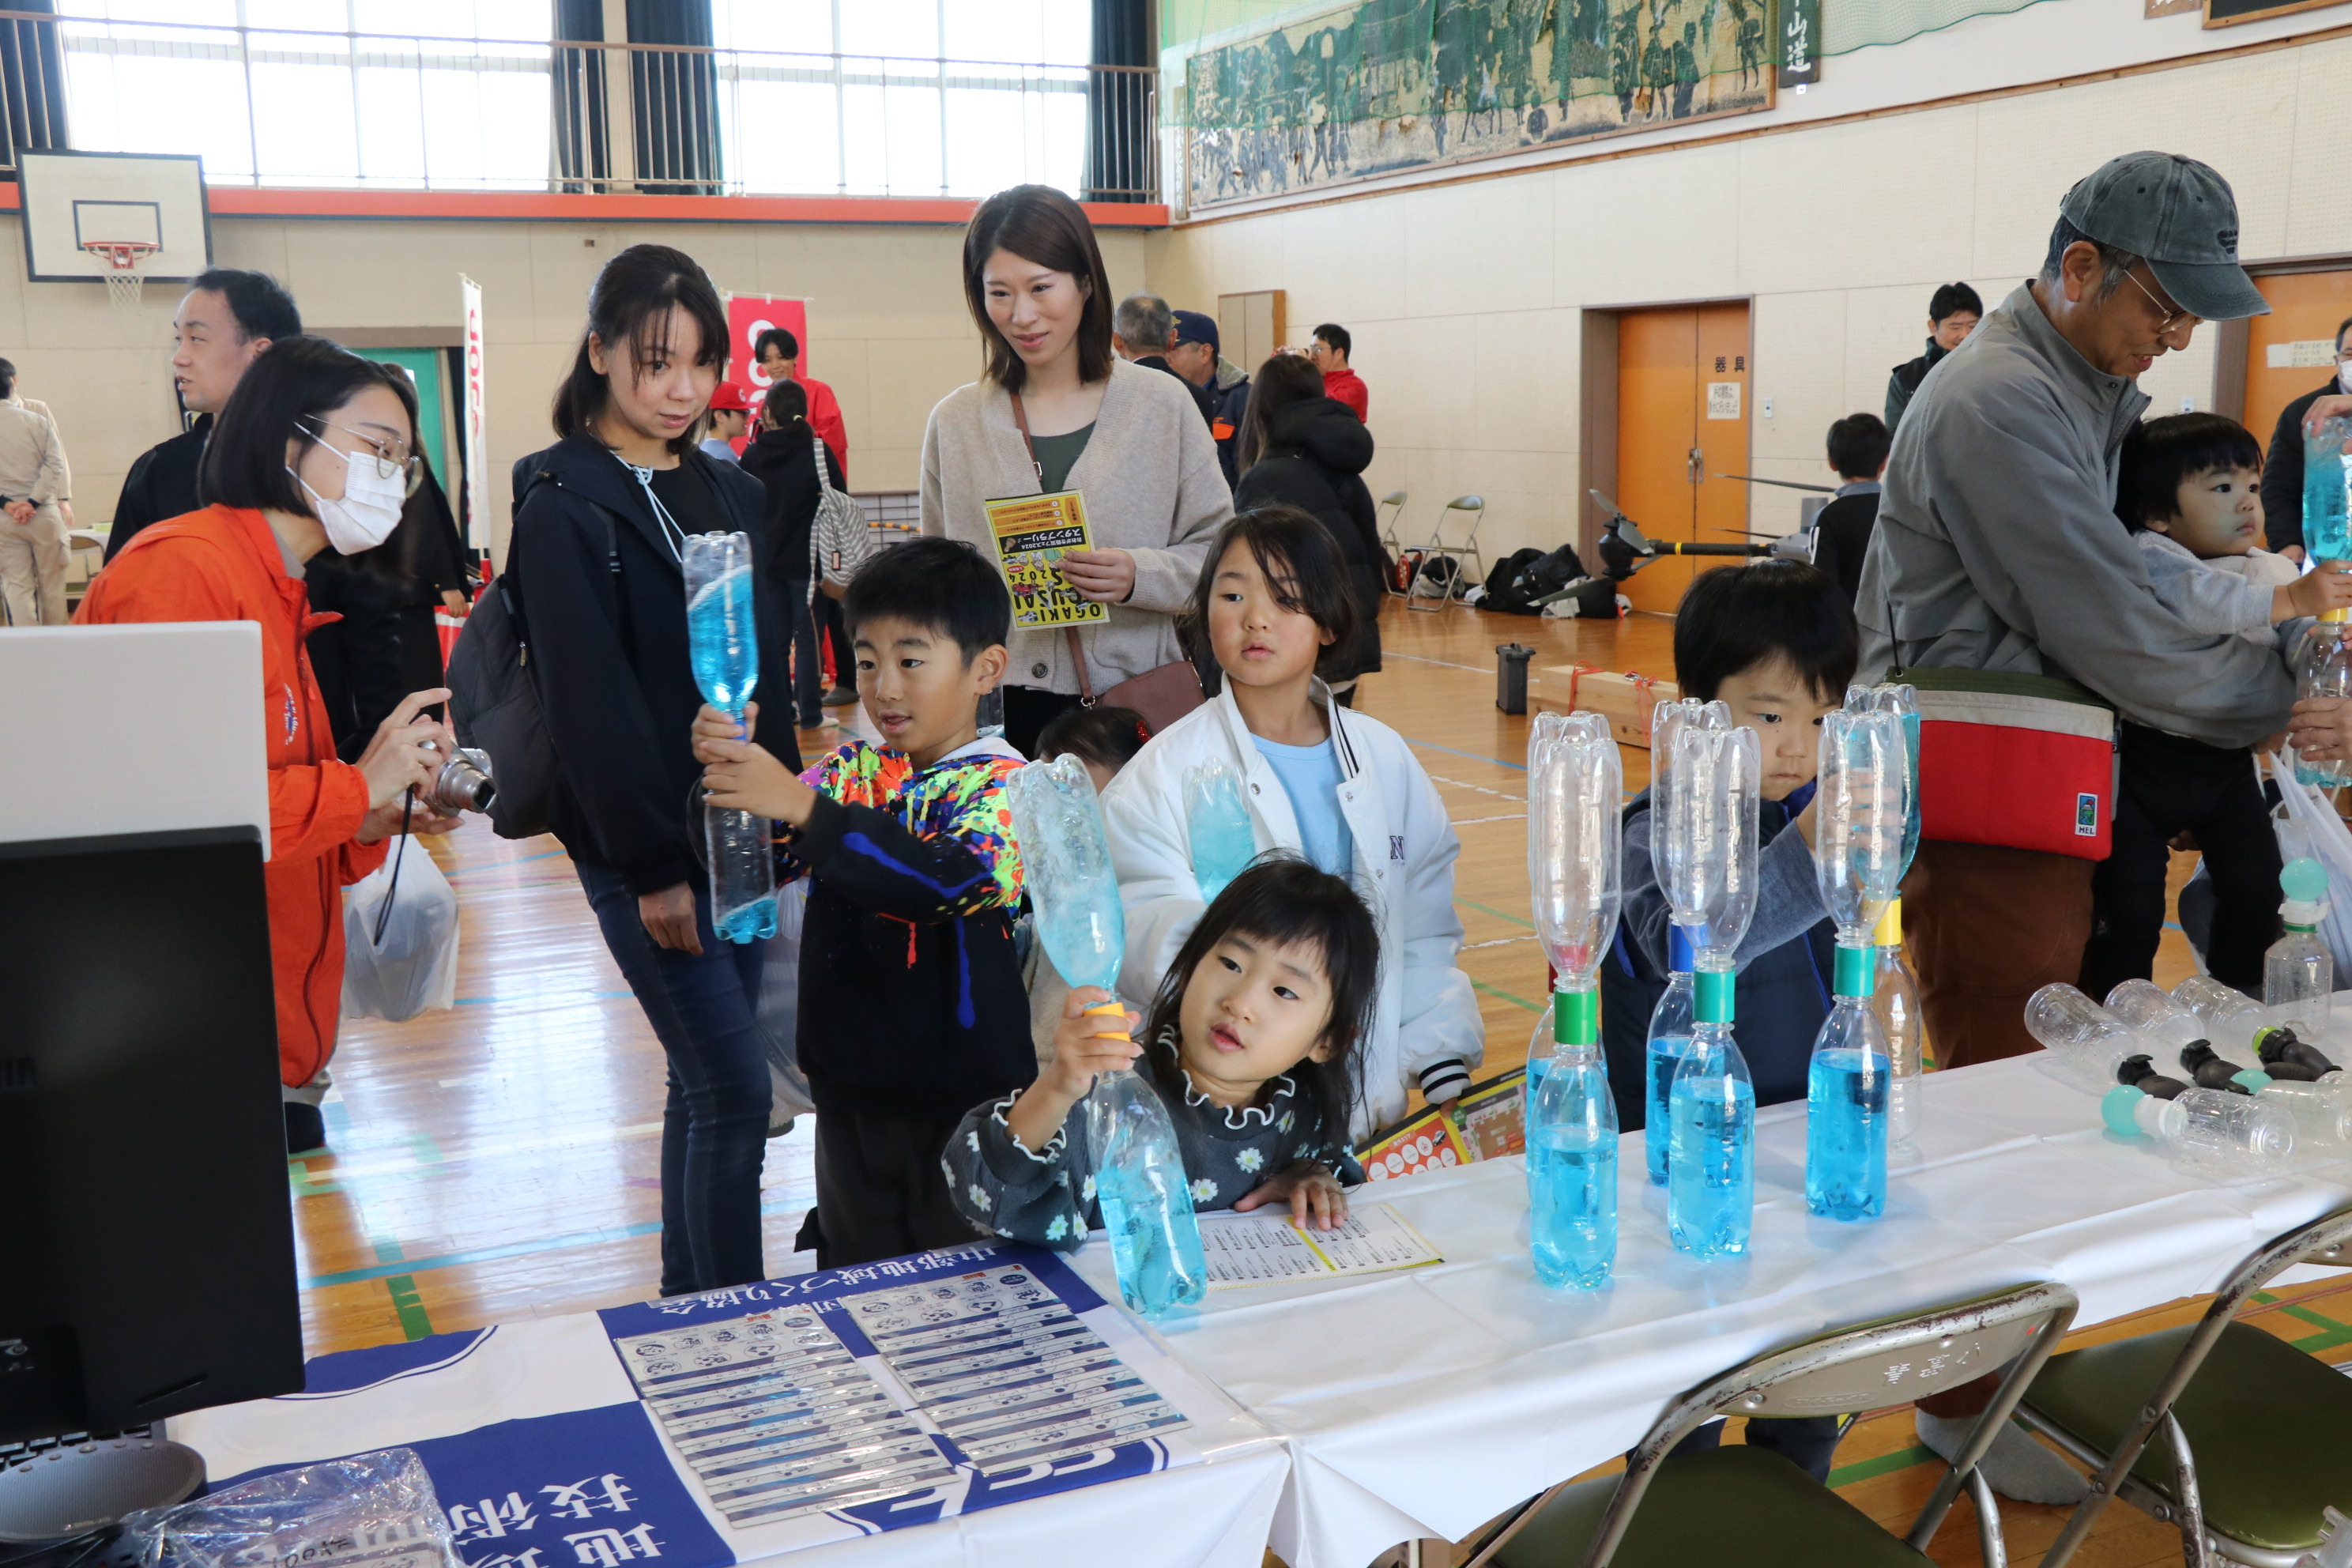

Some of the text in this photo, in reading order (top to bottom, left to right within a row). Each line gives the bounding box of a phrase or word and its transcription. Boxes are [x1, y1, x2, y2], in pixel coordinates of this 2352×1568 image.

[1787, 0, 1811, 73] 山道
[1714, 356, 1745, 373] 器具
[1021, 537, 1082, 549] おおがき防災フェス2024
[1023, 529, 1081, 541] スタンプラリー
[1008, 569, 1047, 582] 2024
[1013, 586, 1083, 610] OUSAI
[1039, 603, 1101, 622] OGAKI
[2079, 826, 2094, 835] MEL
[1389, 835, 1404, 860] N
[659, 1246, 996, 1316] 中部地域づくり協会
[447, 1472, 633, 1540] 技術
